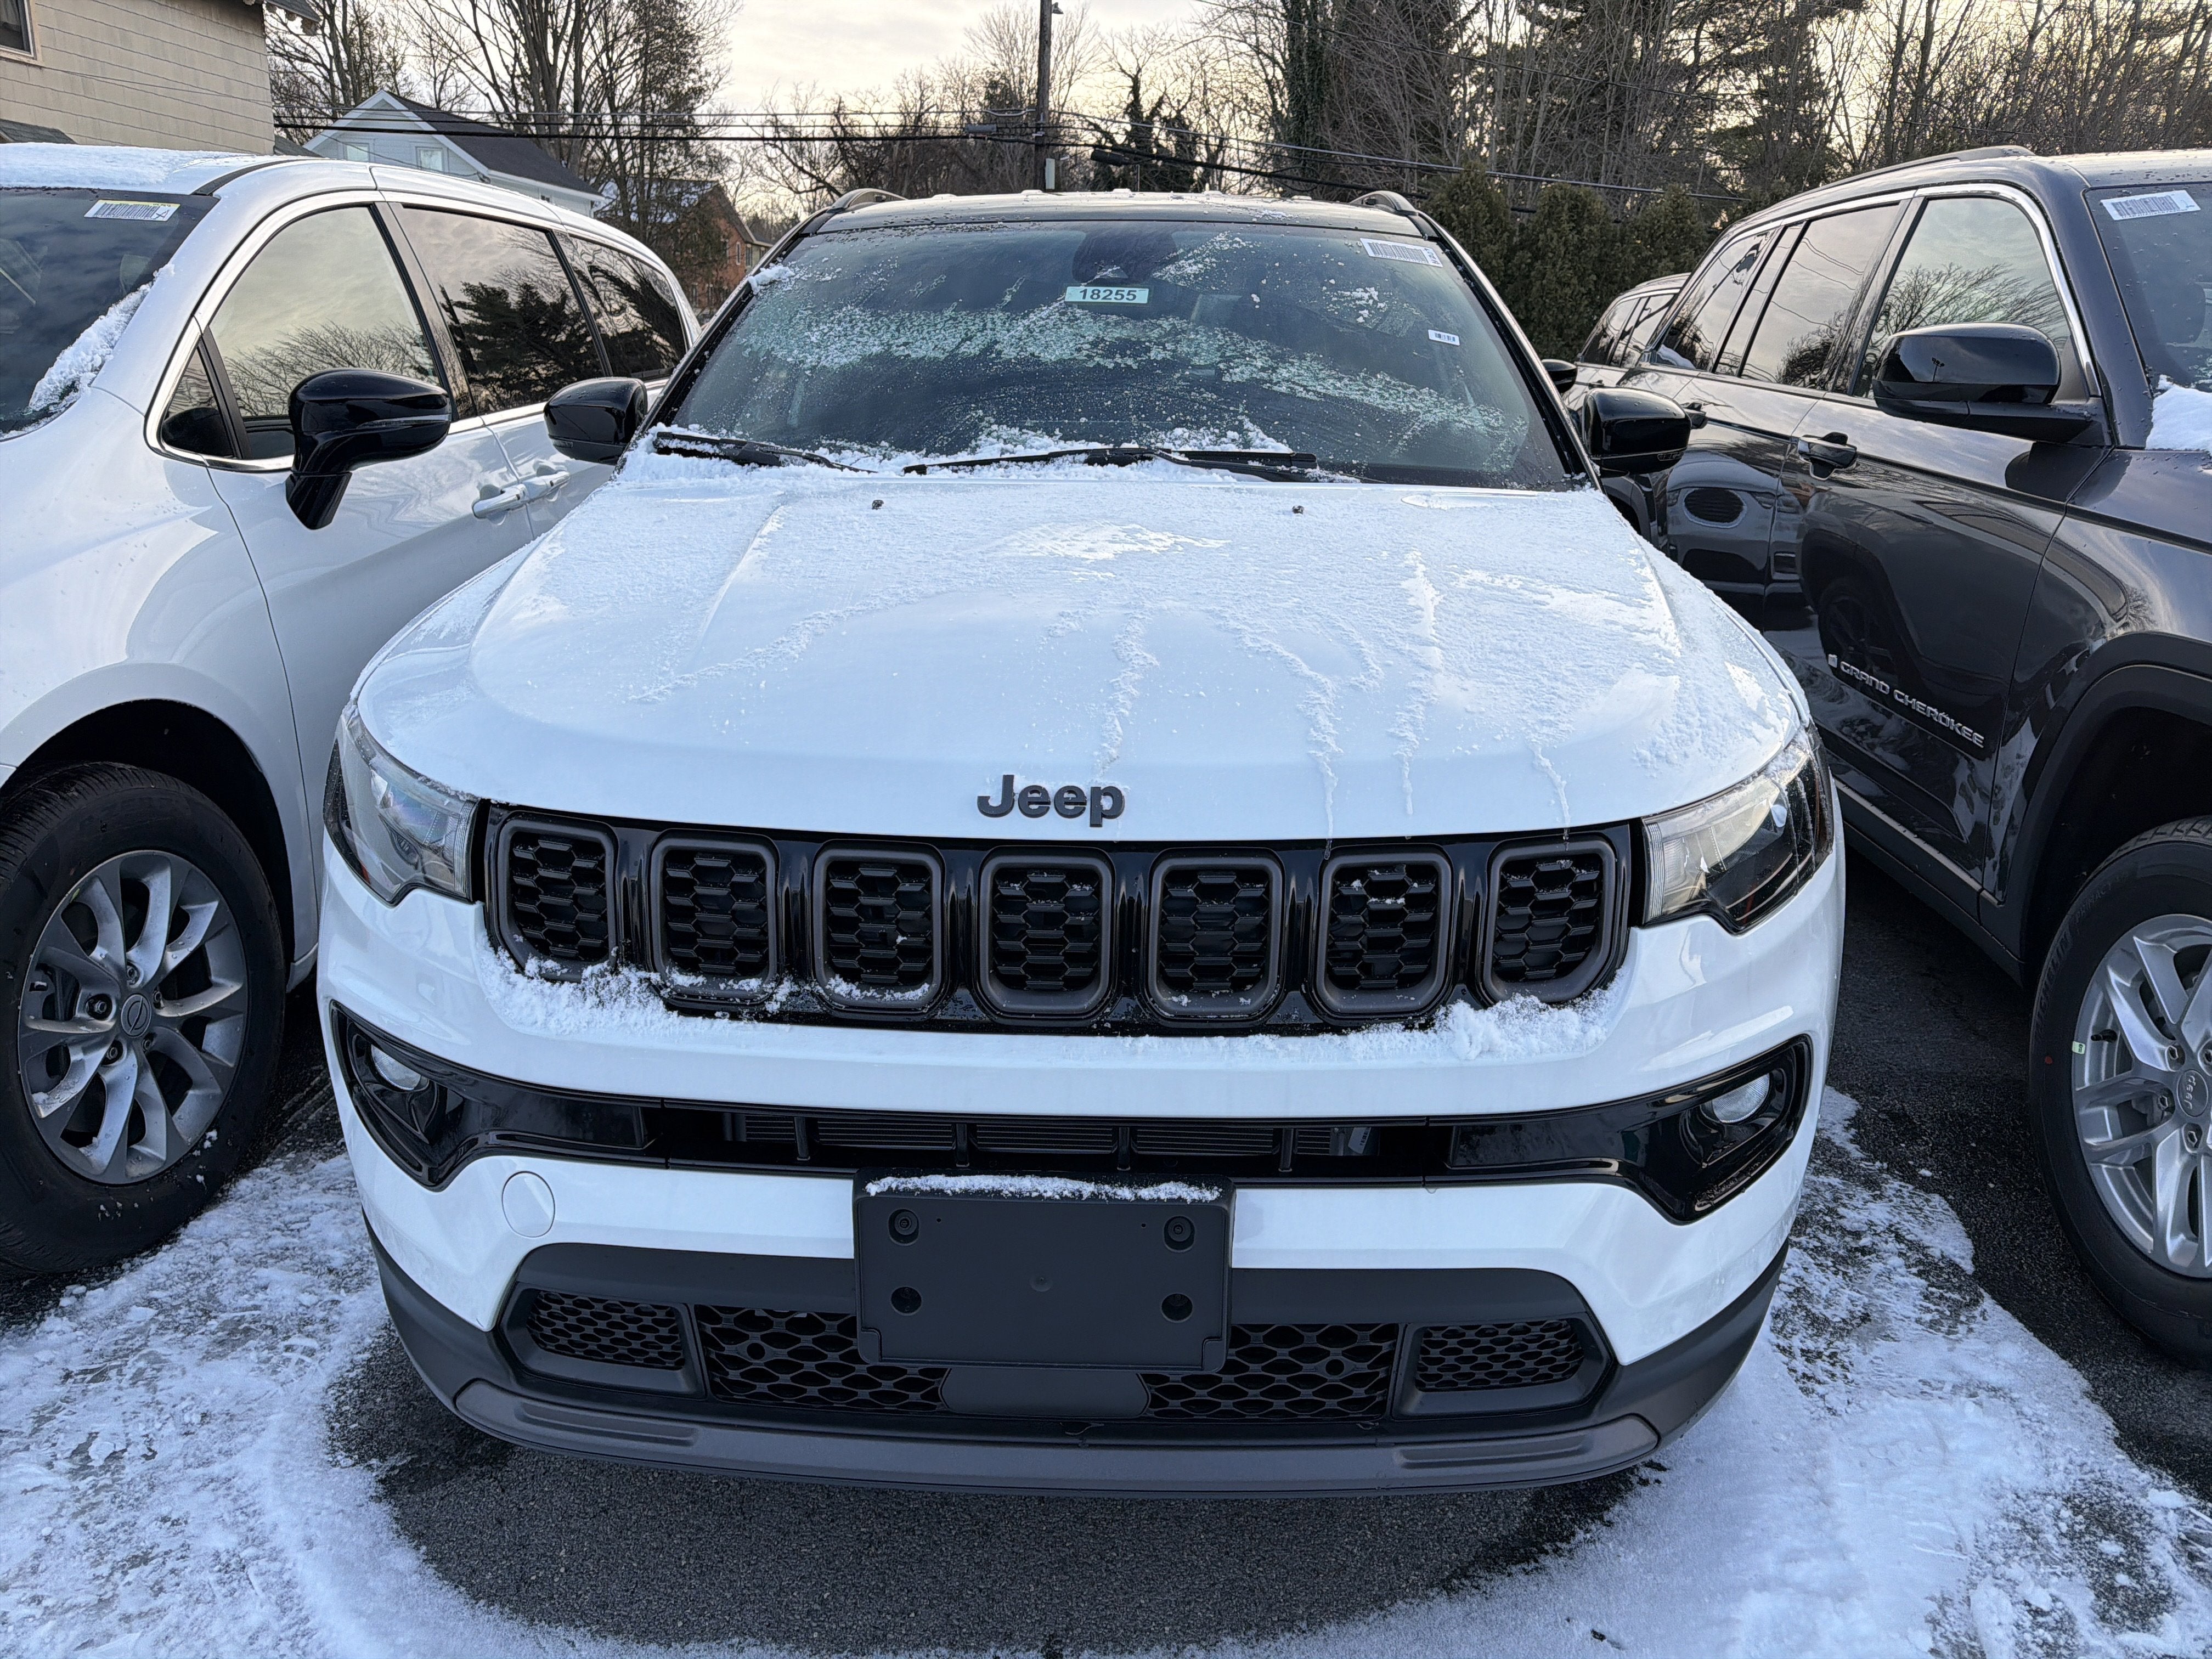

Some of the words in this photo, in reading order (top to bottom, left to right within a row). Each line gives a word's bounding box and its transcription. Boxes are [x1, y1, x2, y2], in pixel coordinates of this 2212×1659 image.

[1079, 288, 1137, 301] 18255
[1840, 661, 1890, 695] GRAND
[1894, 689, 1984, 748] CHEROKEE
[977, 774, 1125, 827] Jeep
[2183, 1075, 2196, 1110] Jeep
